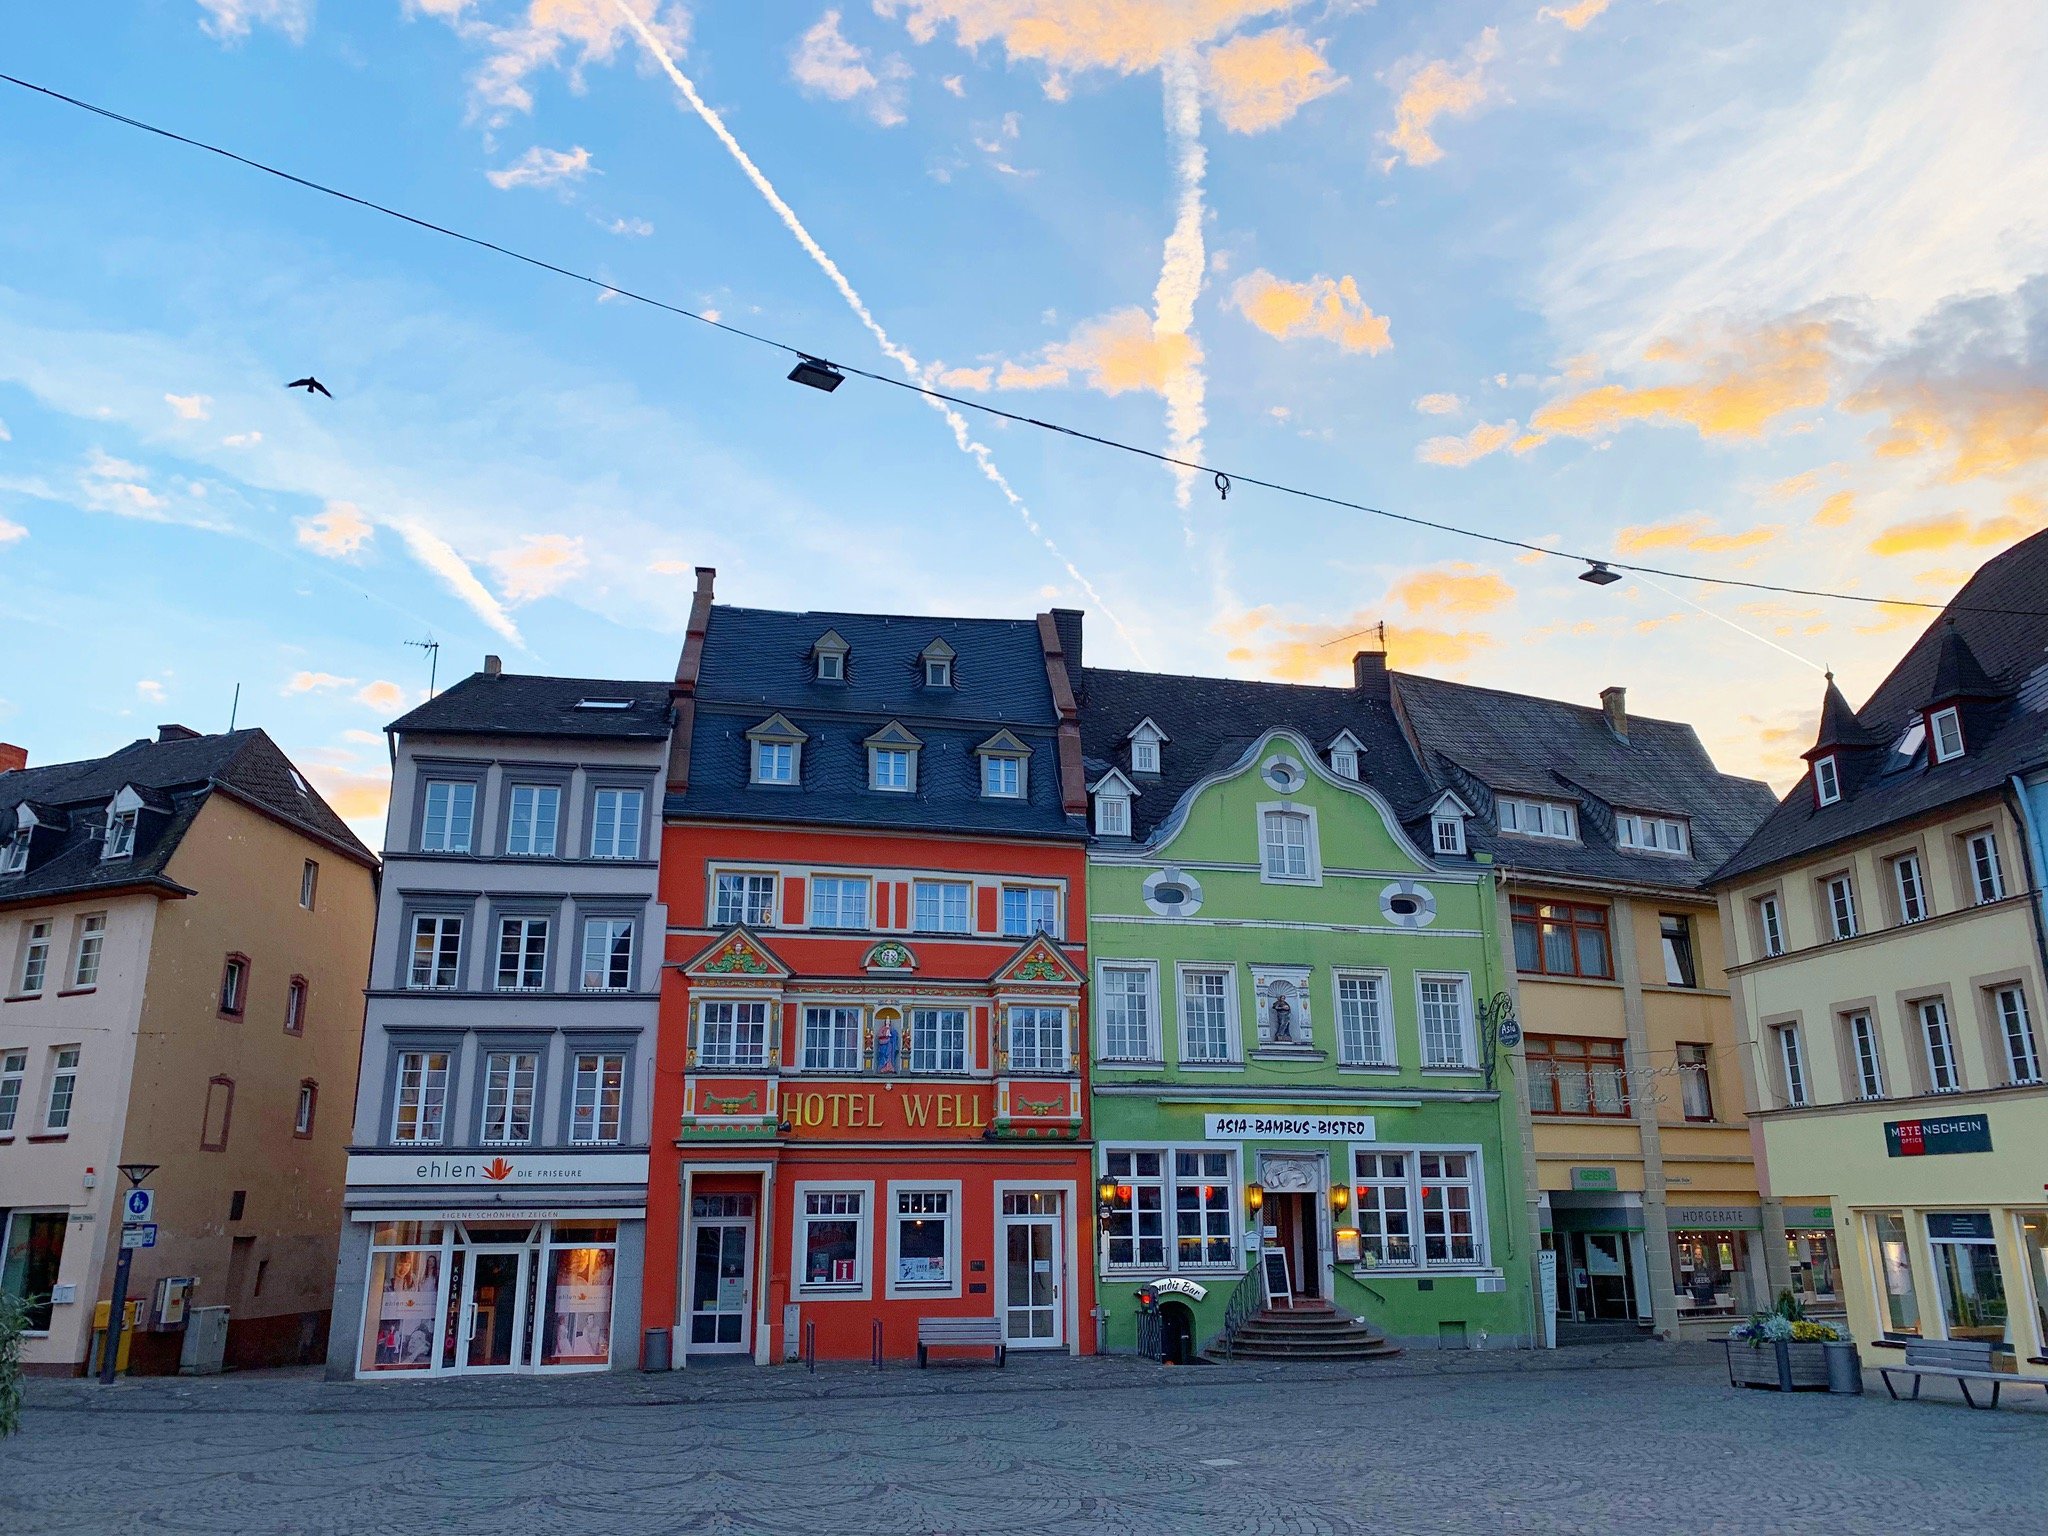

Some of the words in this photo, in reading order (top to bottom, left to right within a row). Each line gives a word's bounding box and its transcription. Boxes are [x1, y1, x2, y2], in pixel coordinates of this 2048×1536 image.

[1502, 1022, 1516, 1034] Asia
[782, 1092, 884, 1127] HOTEL
[902, 1094, 989, 1127] WELL
[1217, 1118, 1365, 1135] ASIA-BAMBUS-BISTRO
[1891, 1121, 1982, 1137] MEYENSCHEIN
[416, 1161, 476, 1178] ehlen
[537, 1169, 582, 1177] FRISEURE
[1182, 1281, 1201, 1296] Bar
[448, 1265, 459, 1336] KOSMETIK
